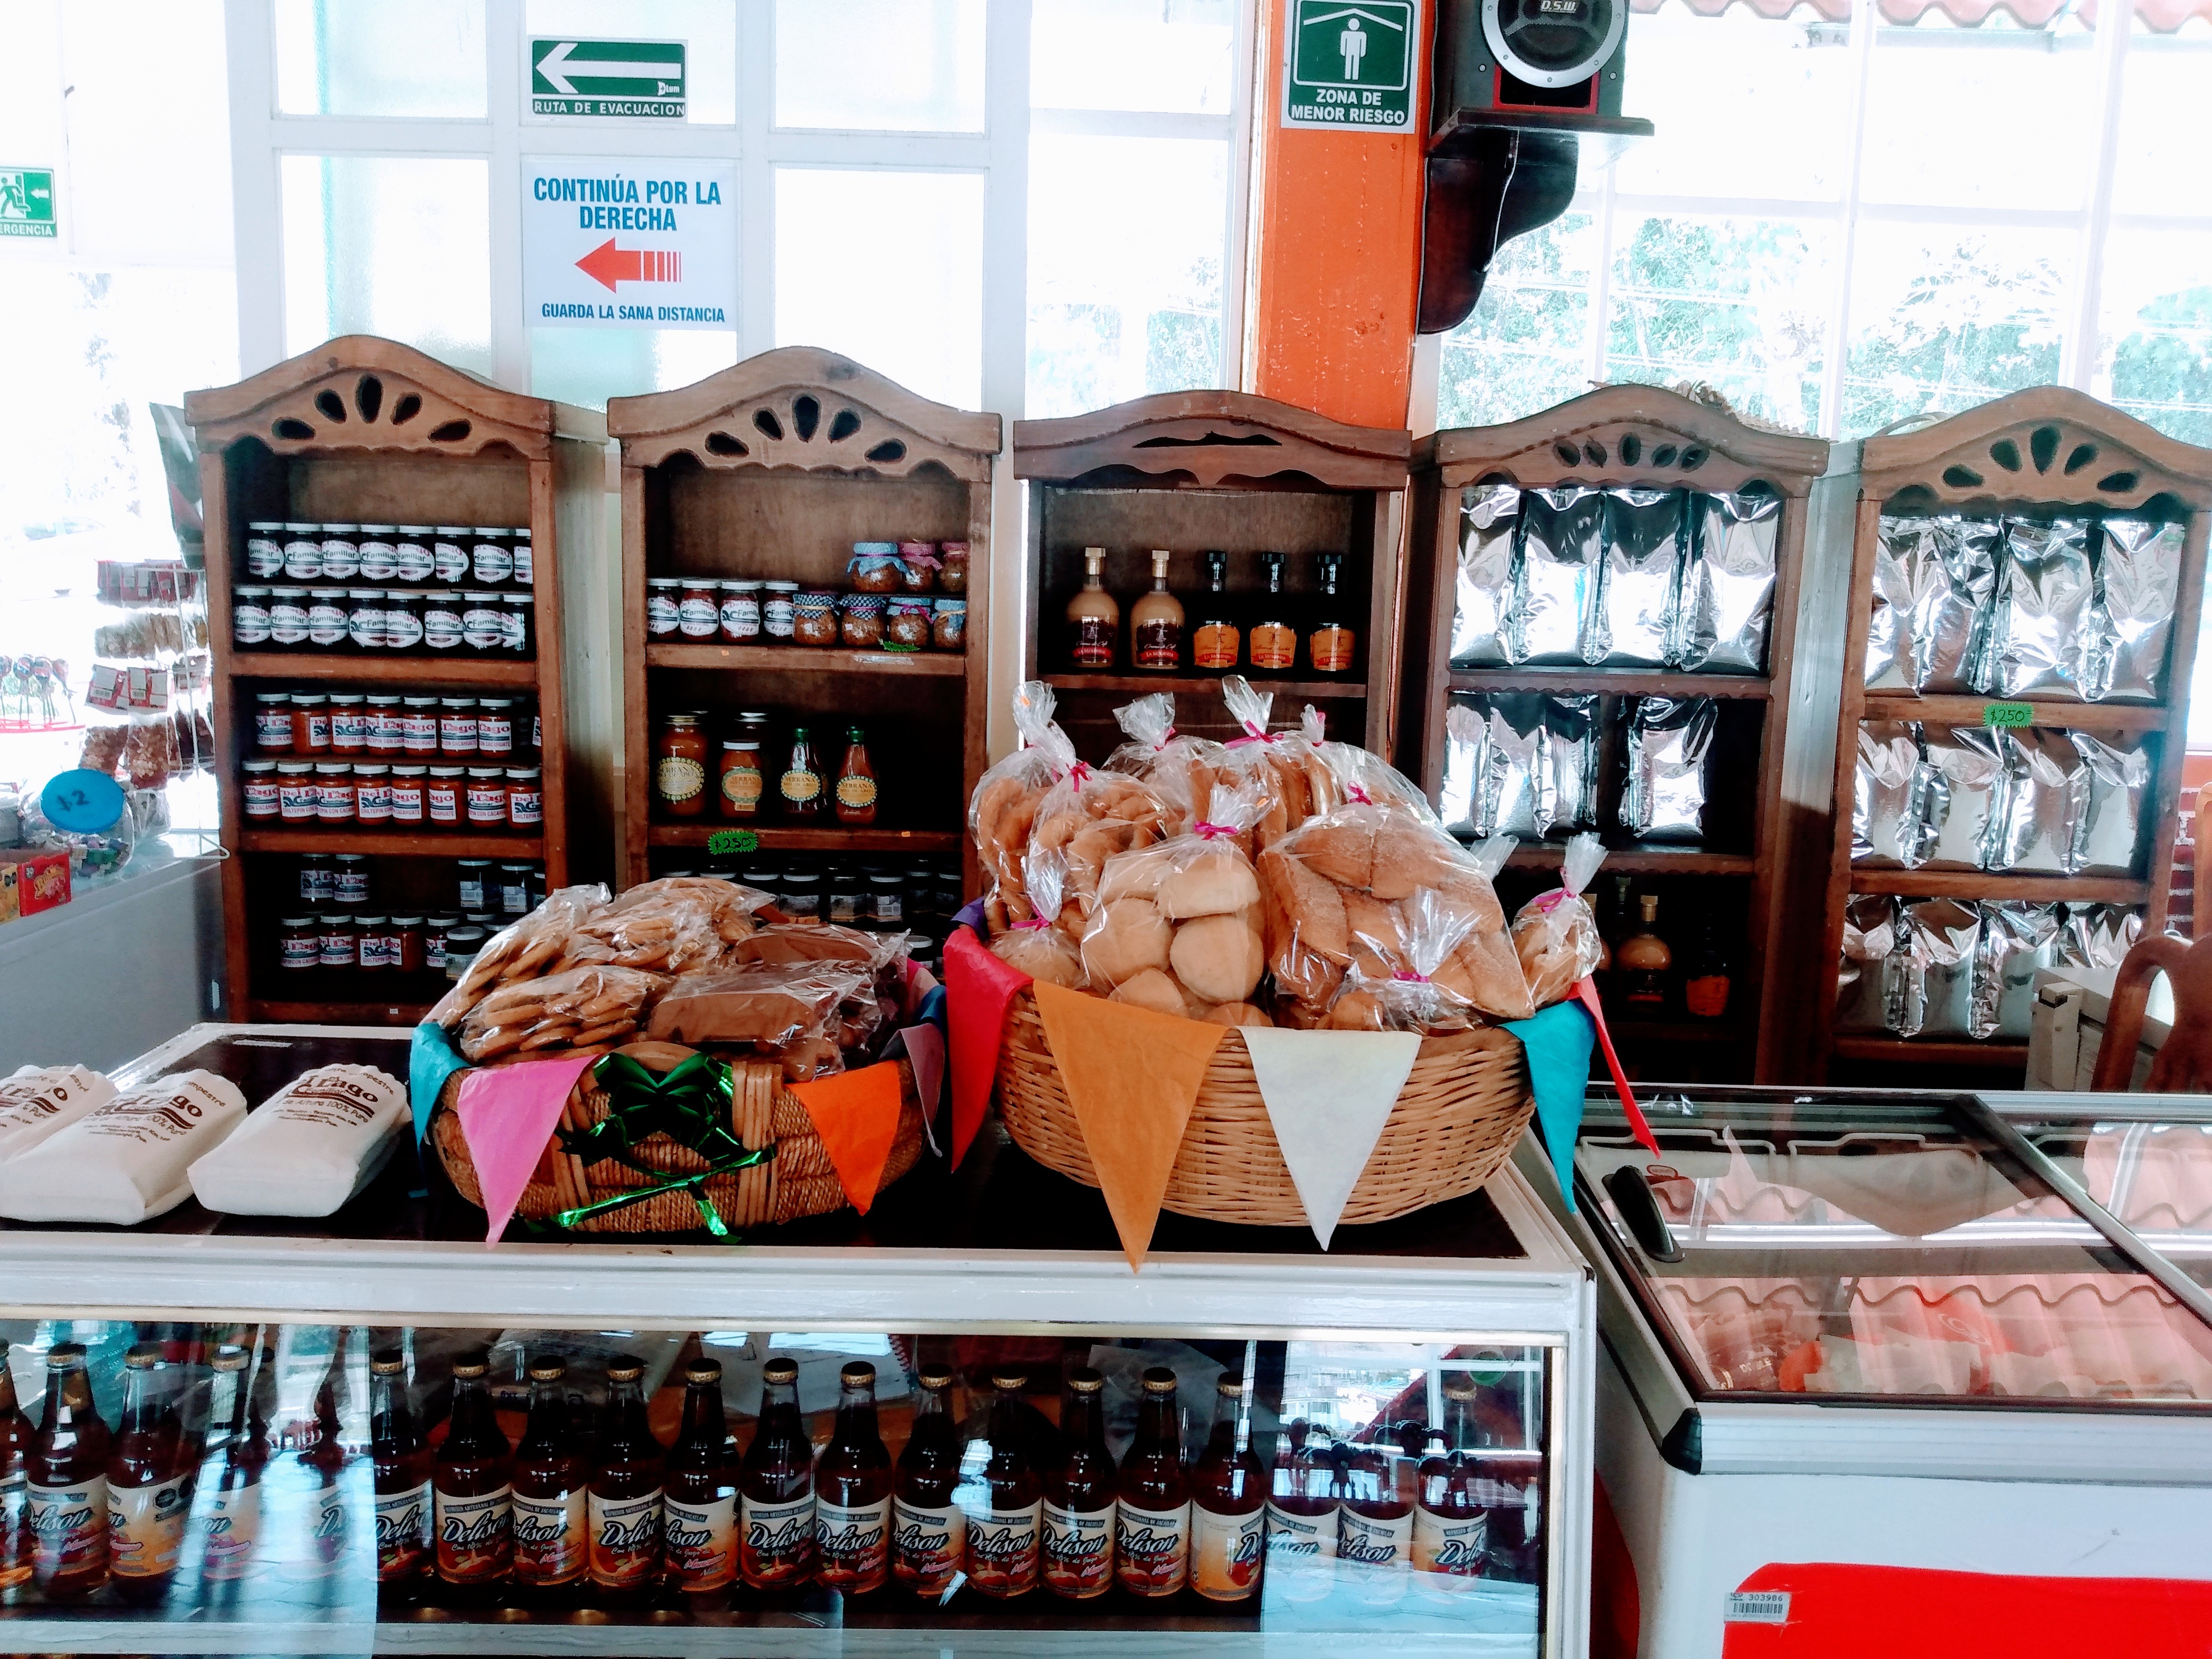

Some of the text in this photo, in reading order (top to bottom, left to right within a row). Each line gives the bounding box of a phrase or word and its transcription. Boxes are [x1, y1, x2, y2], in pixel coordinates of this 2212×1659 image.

[534, 101, 685, 116] RUTA DE EVACUACION
[1316, 89, 1382, 106] ZONA DE
[1291, 104, 1405, 124] MENOR RIESGO
[534, 173, 722, 205] CONTINÚA POR LA
[580, 205, 677, 231] DERECHA
[541, 303, 725, 323] GUARDA LA SANA DISTANCIA
[686, 609, 715, 618] Familiar
[187, 1082, 226, 1107] mpestre
[315, 1077, 379, 1102] Lago
[326, 1101, 349, 1112] 100%
[350, 1109, 368, 1123] Puro
[165, 1124, 187, 1136] Puro
[513, 1515, 566, 1541] elison
[666, 1519, 711, 1546] lison
[817, 1520, 883, 1551] Delison
[969, 1522, 1033, 1553] Delison
[1043, 1524, 1104, 1555] Delison
[831, 1551, 846, 1560] 10%
